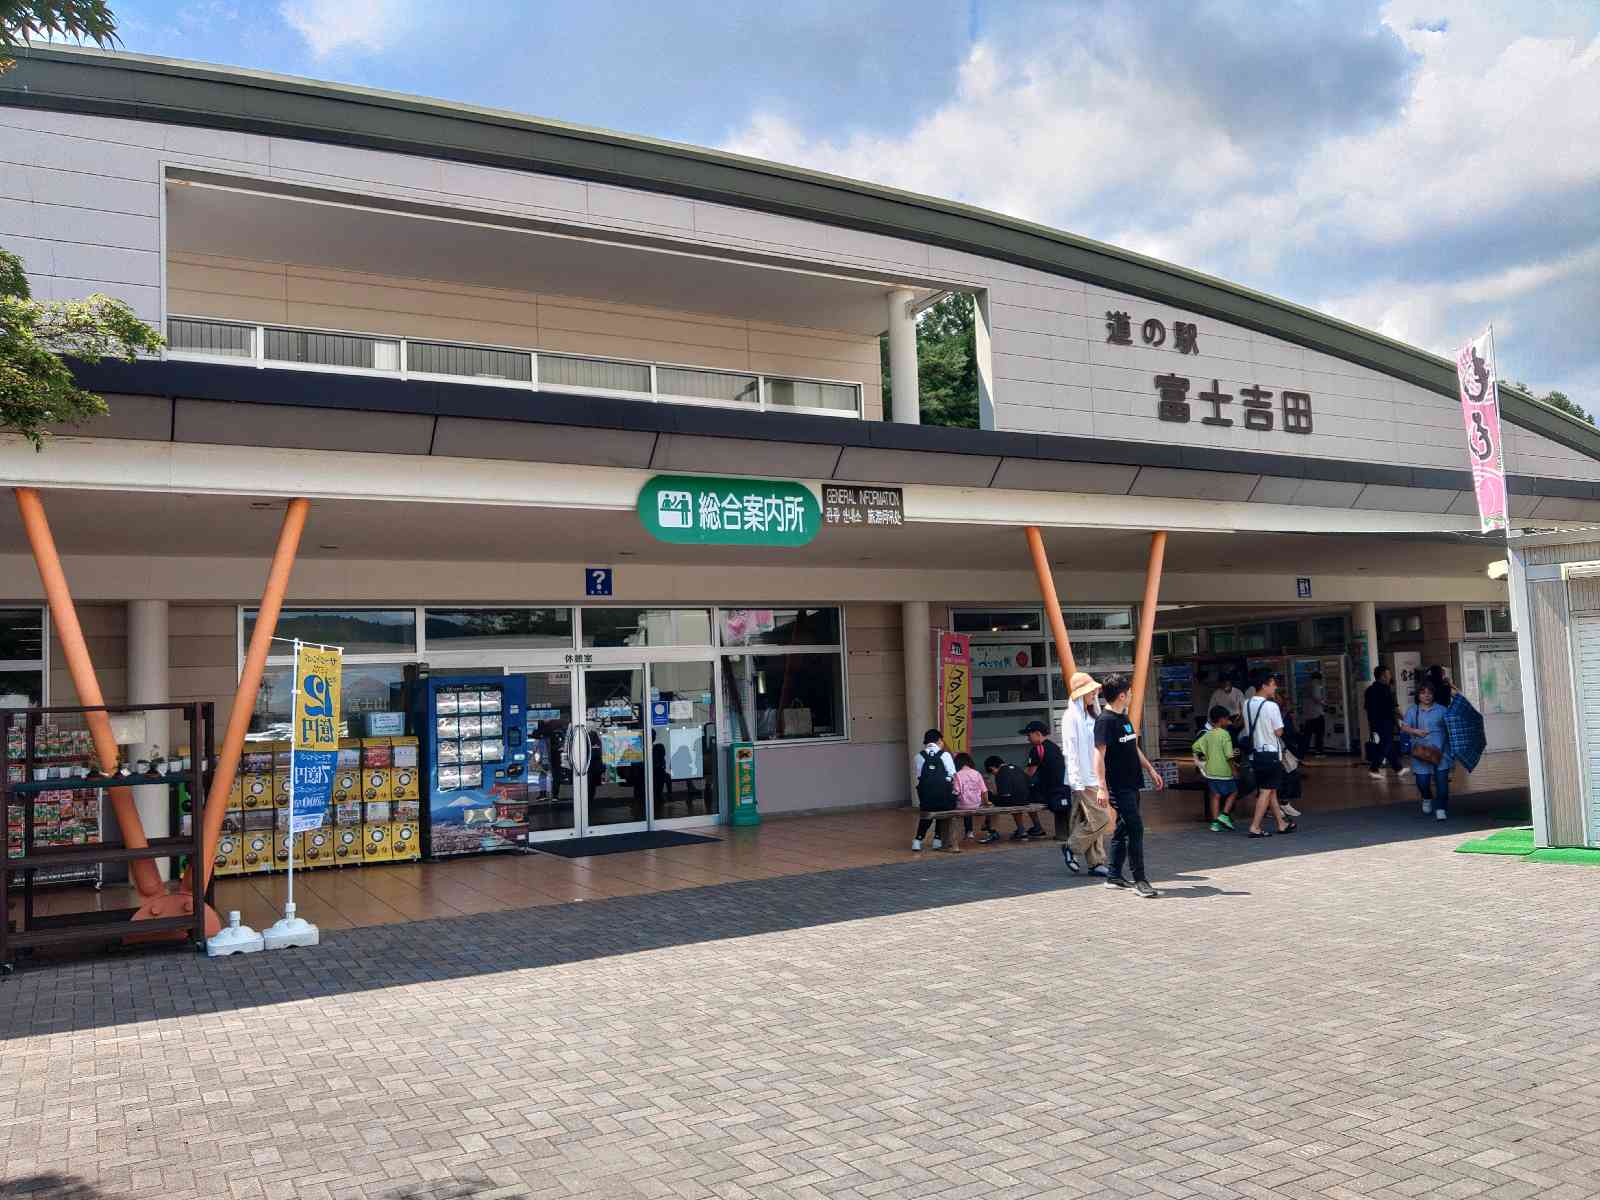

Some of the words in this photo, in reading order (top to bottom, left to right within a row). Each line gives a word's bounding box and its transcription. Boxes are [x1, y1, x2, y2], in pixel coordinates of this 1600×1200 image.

[1105, 310, 1200, 356] 道の駅
[1154, 372, 1313, 435] 富士吉田
[699, 491, 805, 534] 総合案内所
[826, 488, 857, 505] GENERAL
[859, 489, 900, 507] INFORMATION
